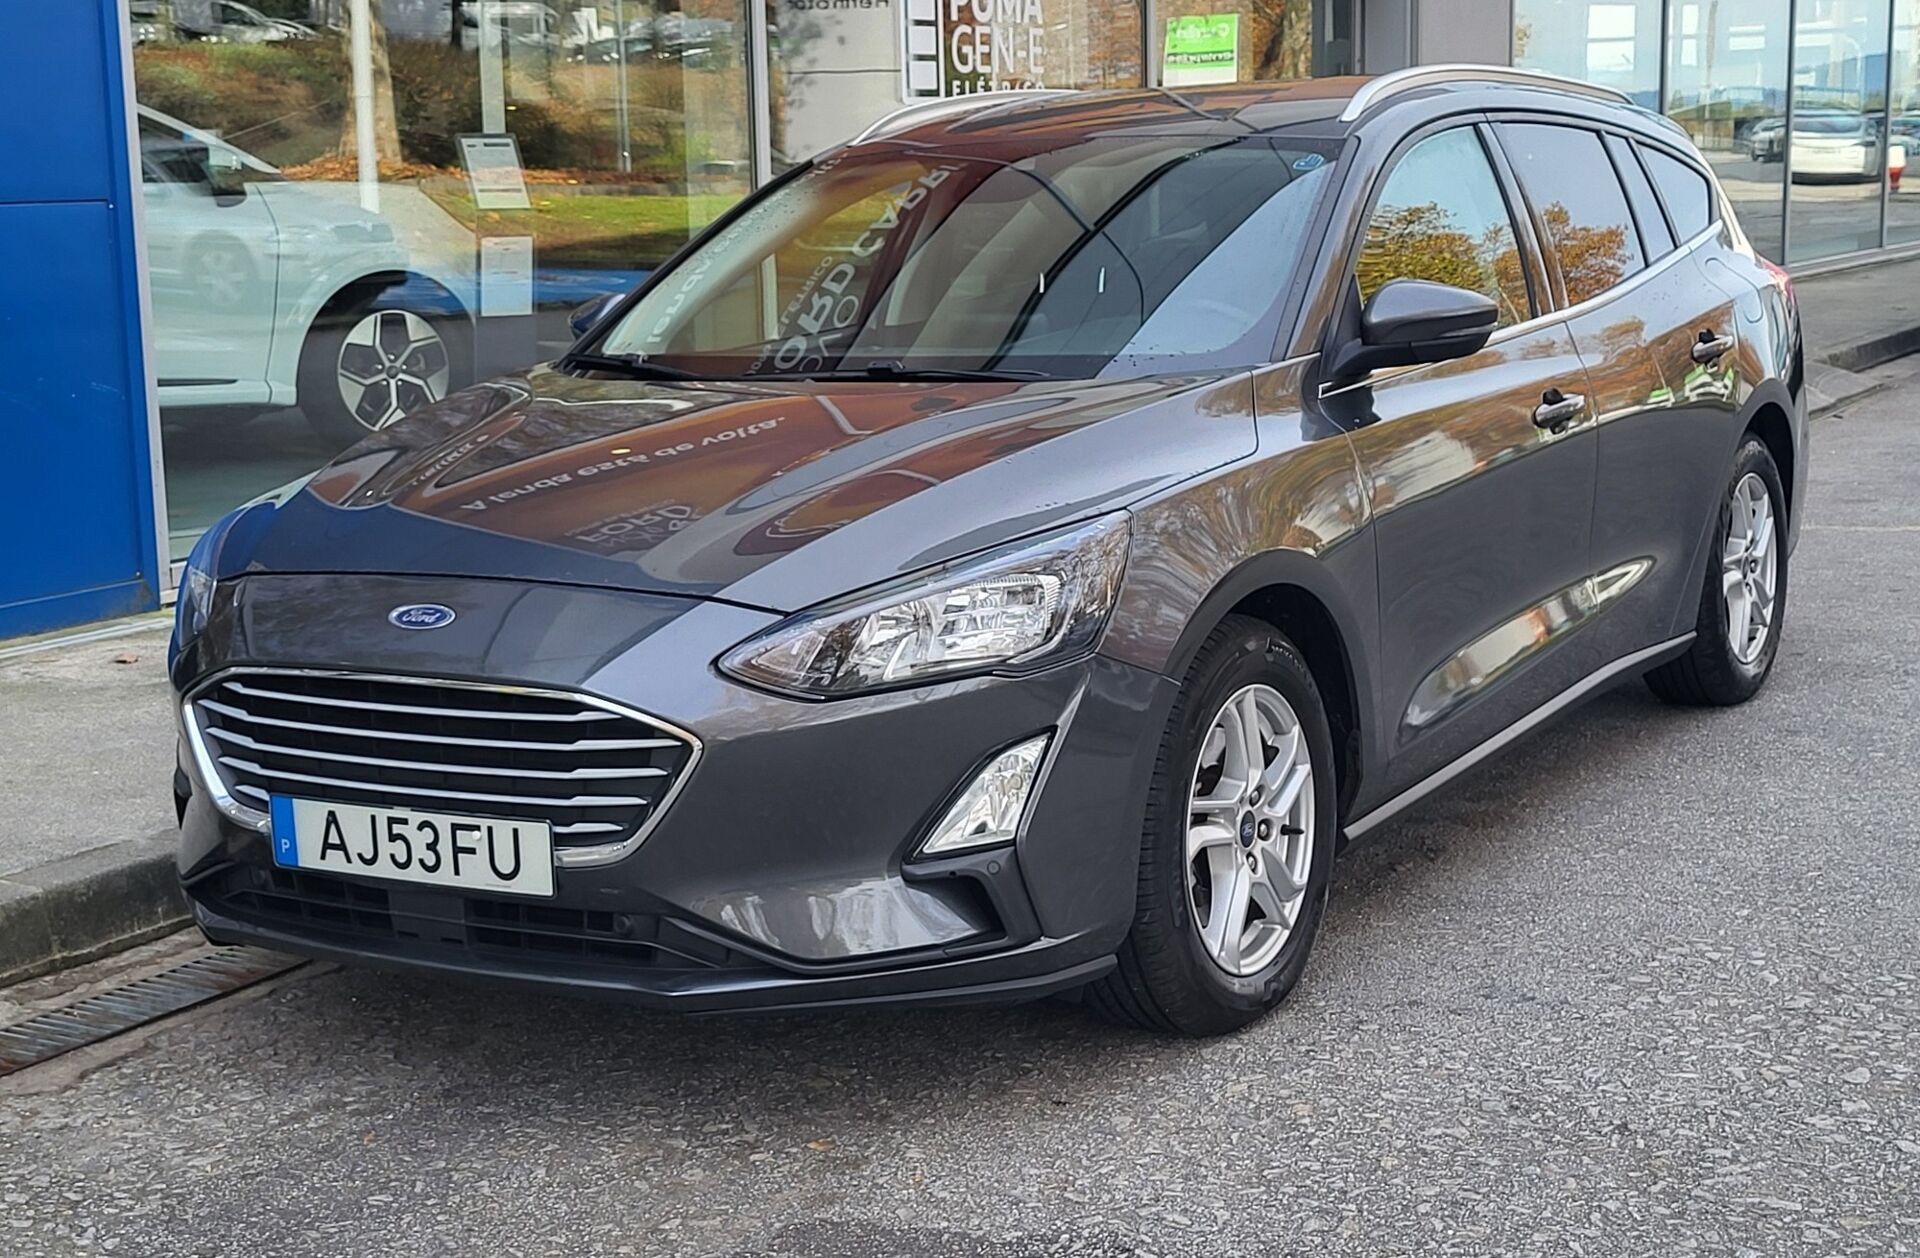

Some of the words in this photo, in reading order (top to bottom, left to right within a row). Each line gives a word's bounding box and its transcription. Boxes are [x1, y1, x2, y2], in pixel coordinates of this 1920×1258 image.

[951, 24, 1045, 74] GEN-E
[401, 607, 441, 624] Ford
[281, 838, 290, 853] P
[319, 809, 521, 882] AJ53FU
